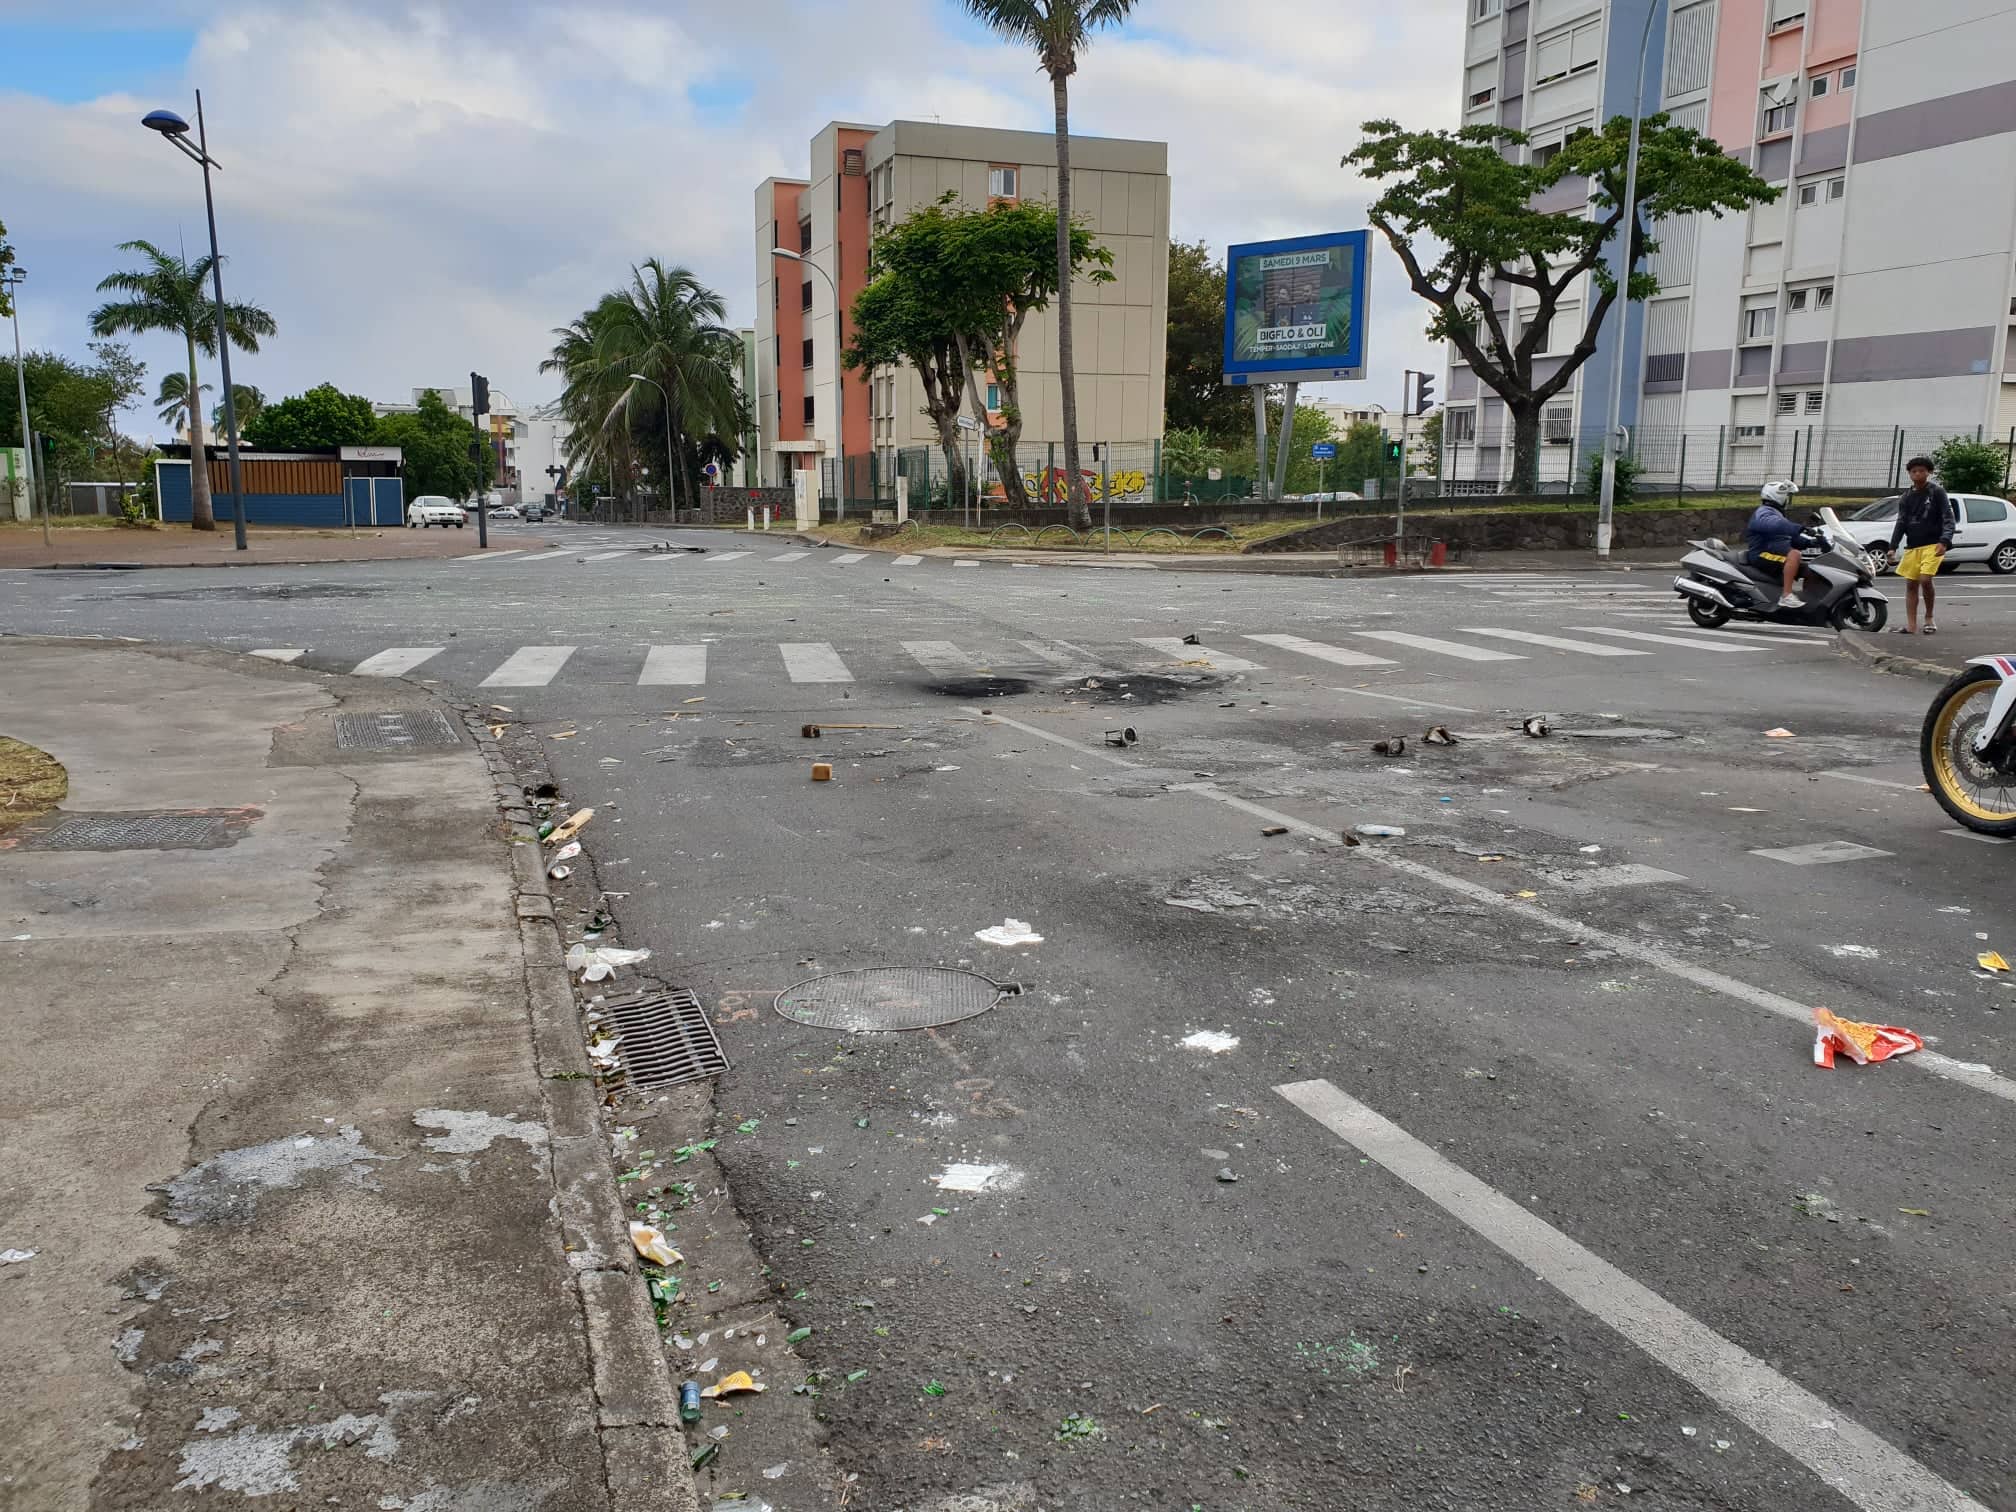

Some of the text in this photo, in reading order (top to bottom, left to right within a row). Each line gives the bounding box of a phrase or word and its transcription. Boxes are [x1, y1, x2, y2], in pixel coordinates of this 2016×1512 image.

[1263, 253, 1327, 268] SAMEDI 9 MARS
[1260, 326, 1323, 341] BIGFLO & OLI
